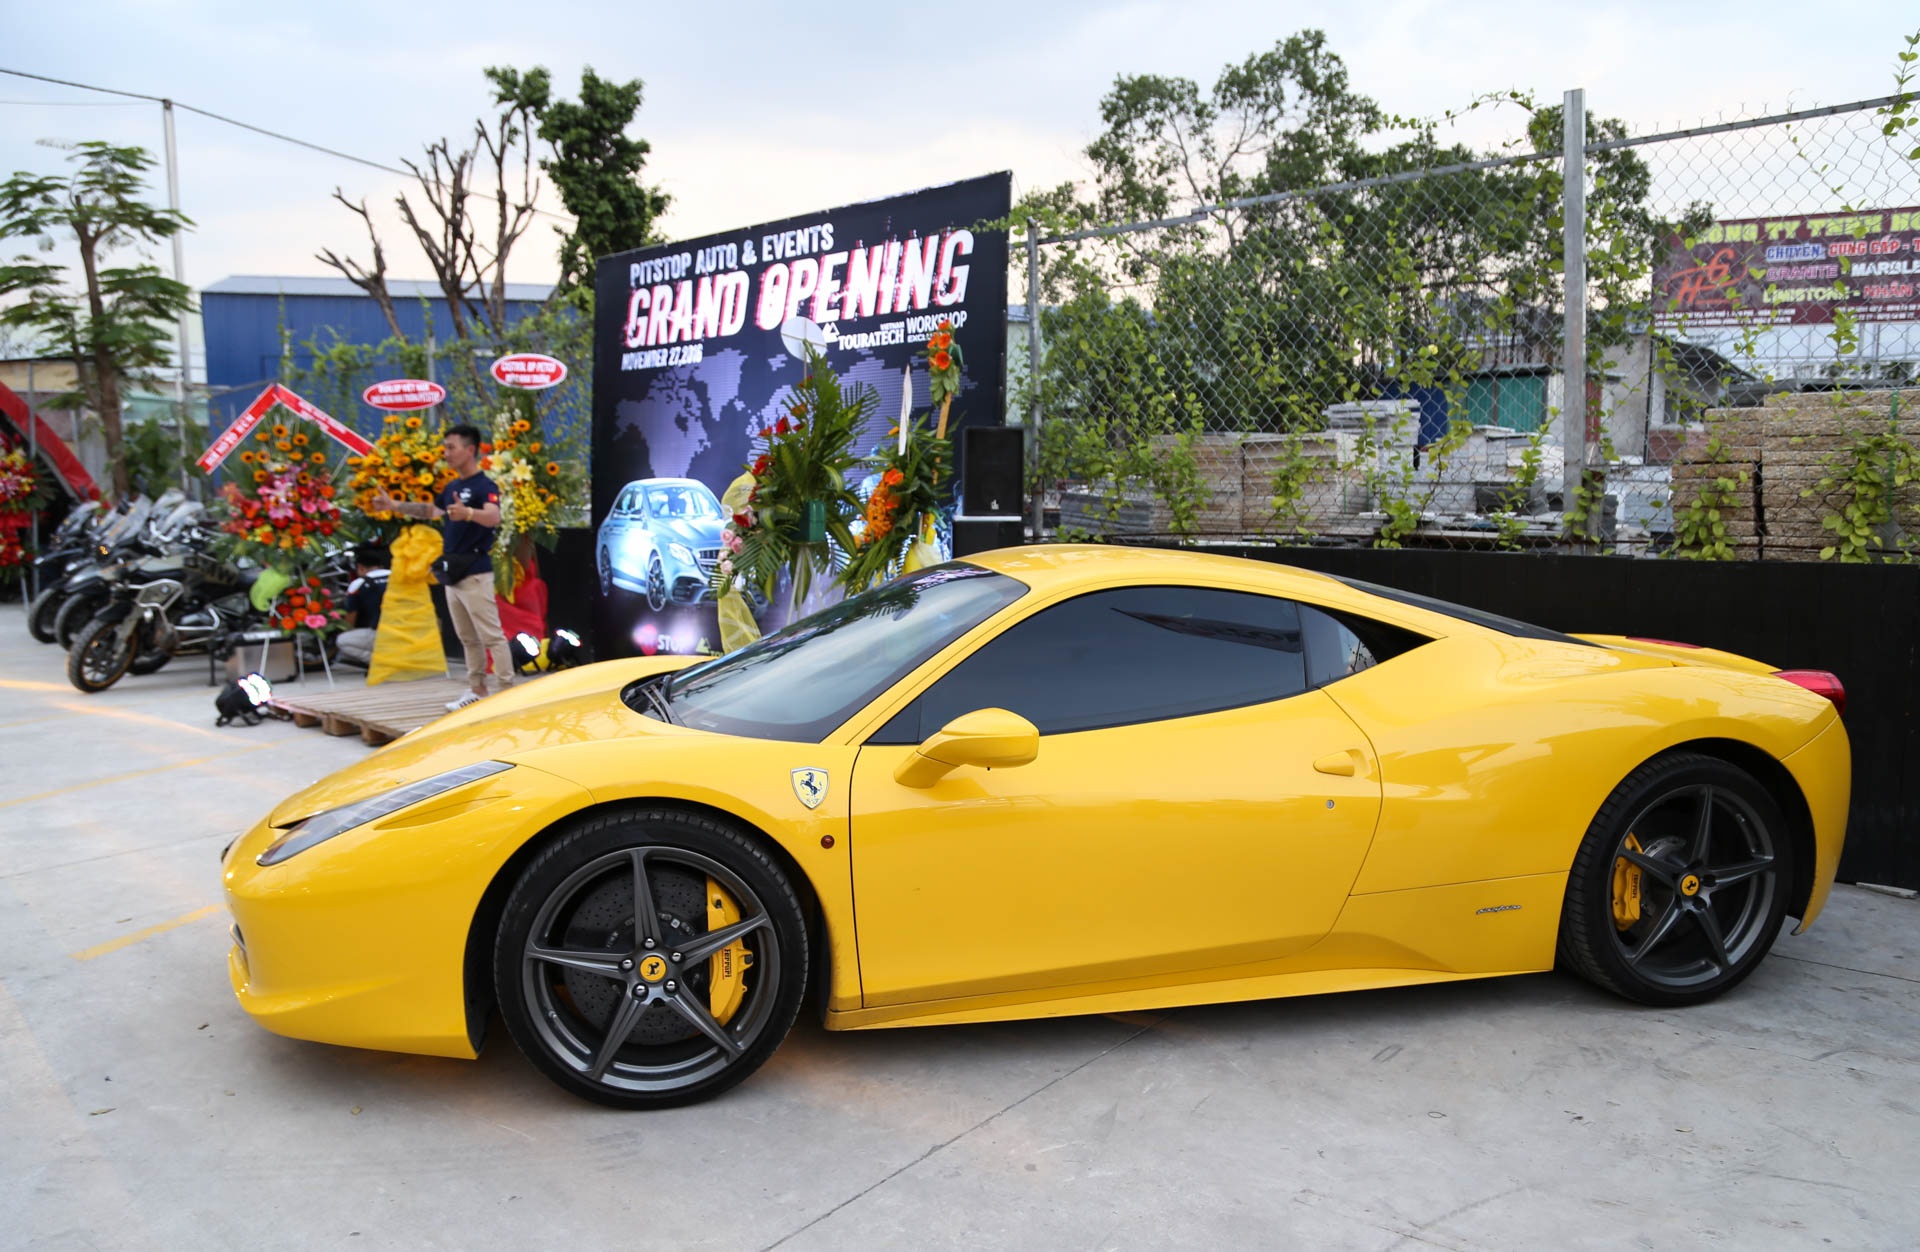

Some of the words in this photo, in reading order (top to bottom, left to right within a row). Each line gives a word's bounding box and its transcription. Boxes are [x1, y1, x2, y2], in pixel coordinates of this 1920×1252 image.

[1765, 220, 1799, 239] TY
[630, 252, 692, 287] PITSTOP
[695, 242, 738, 275] AUTO
[741, 239, 757, 265] &
[762, 222, 834, 261] EVENTS
[1767, 264, 1839, 281] GRANITE
[625, 269, 750, 348] GRAND
[755, 228, 974, 332] OPENING
[906, 310, 967, 334] WORKSHOP
[838, 329, 905, 350] TOURATECH
[621, 348, 668, 371] NOVEMBER
[724, 948, 732, 978] Ferrari
